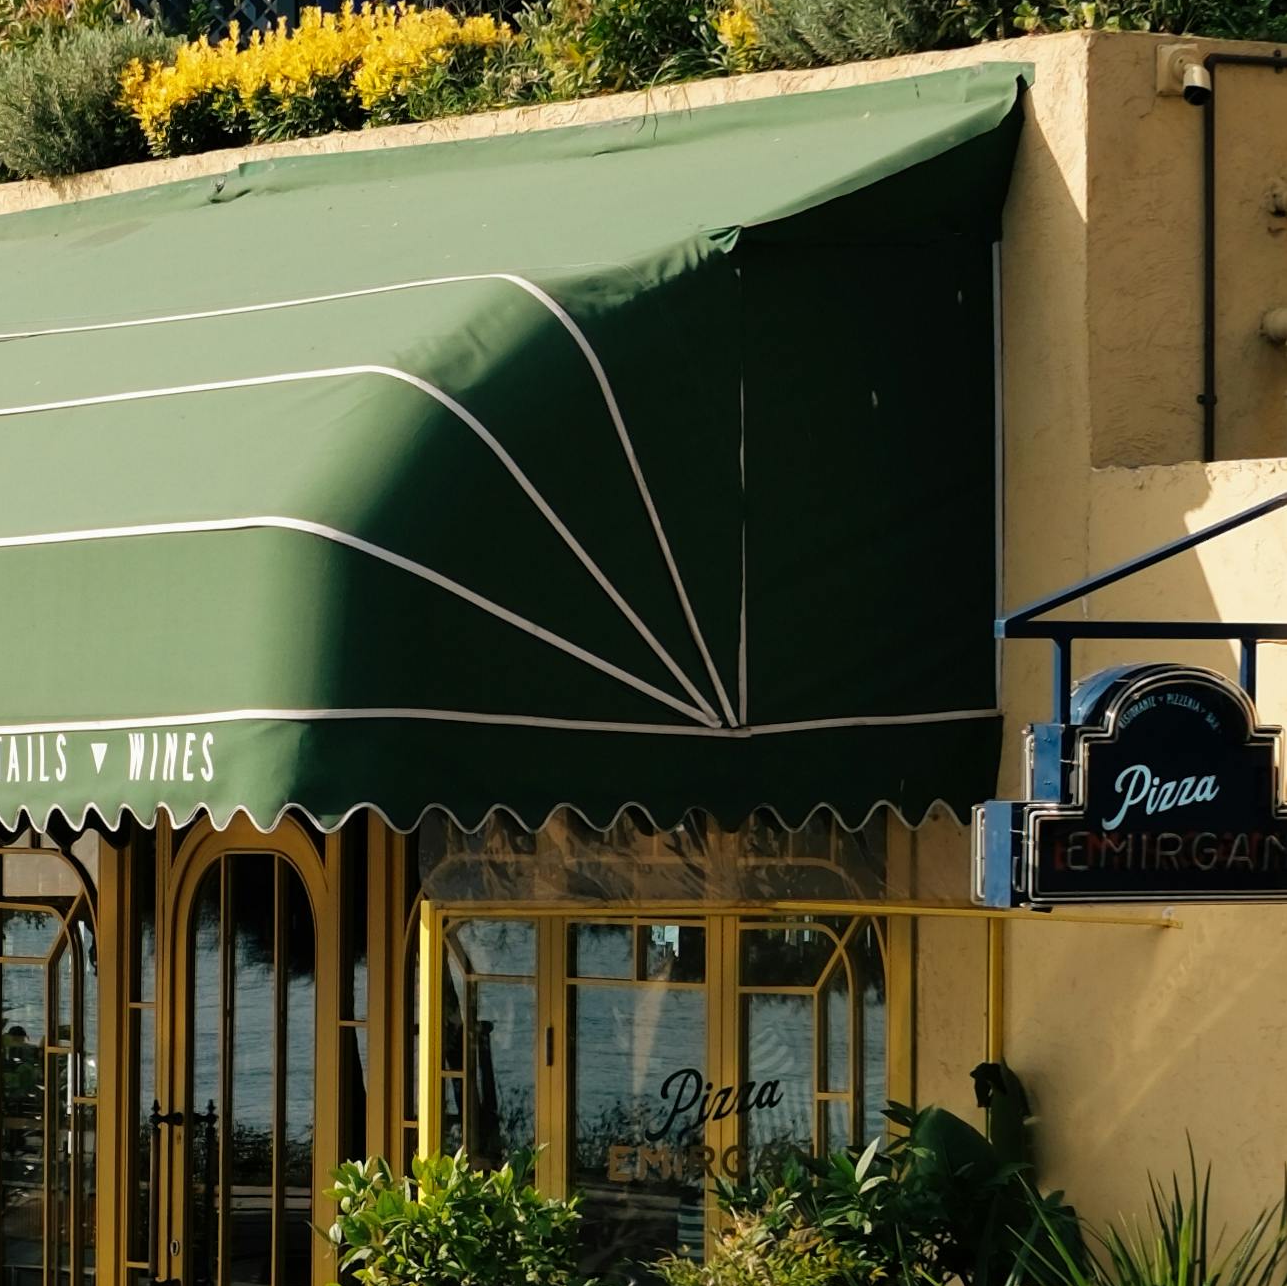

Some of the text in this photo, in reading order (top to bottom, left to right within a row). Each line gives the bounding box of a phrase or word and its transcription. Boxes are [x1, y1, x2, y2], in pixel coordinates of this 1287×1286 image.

[128, 731, 215, 783] WINES
[1101, 764, 1220, 831] Pizza
[645, 1068, 784, 1141] Pizza
